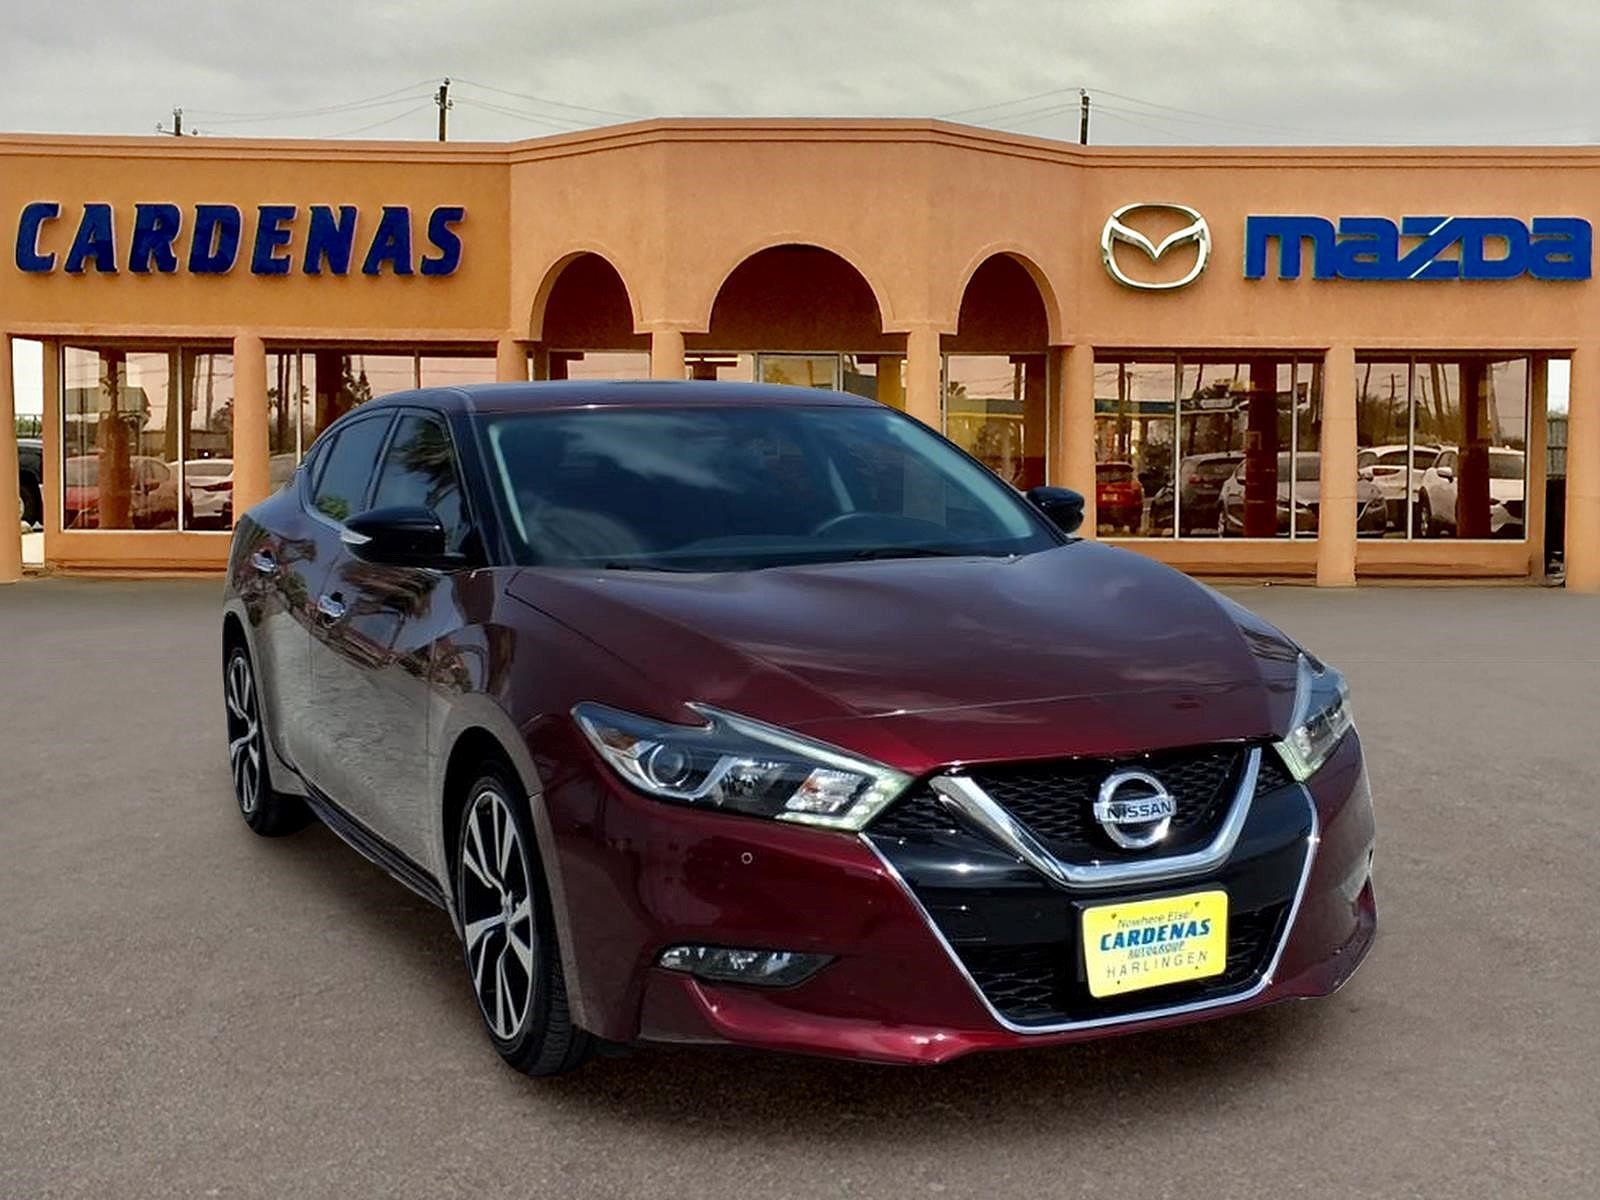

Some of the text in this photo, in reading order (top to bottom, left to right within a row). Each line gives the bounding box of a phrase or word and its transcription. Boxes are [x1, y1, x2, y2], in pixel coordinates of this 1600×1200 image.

[15, 202, 467, 275] CARDENAS
[1107, 801, 1172, 819] NISSAN
[1100, 918, 1211, 951] CARDENAS
[1117, 914, 1165, 929] Nowhere
[1106, 951, 1208, 978] HARLINGEN
